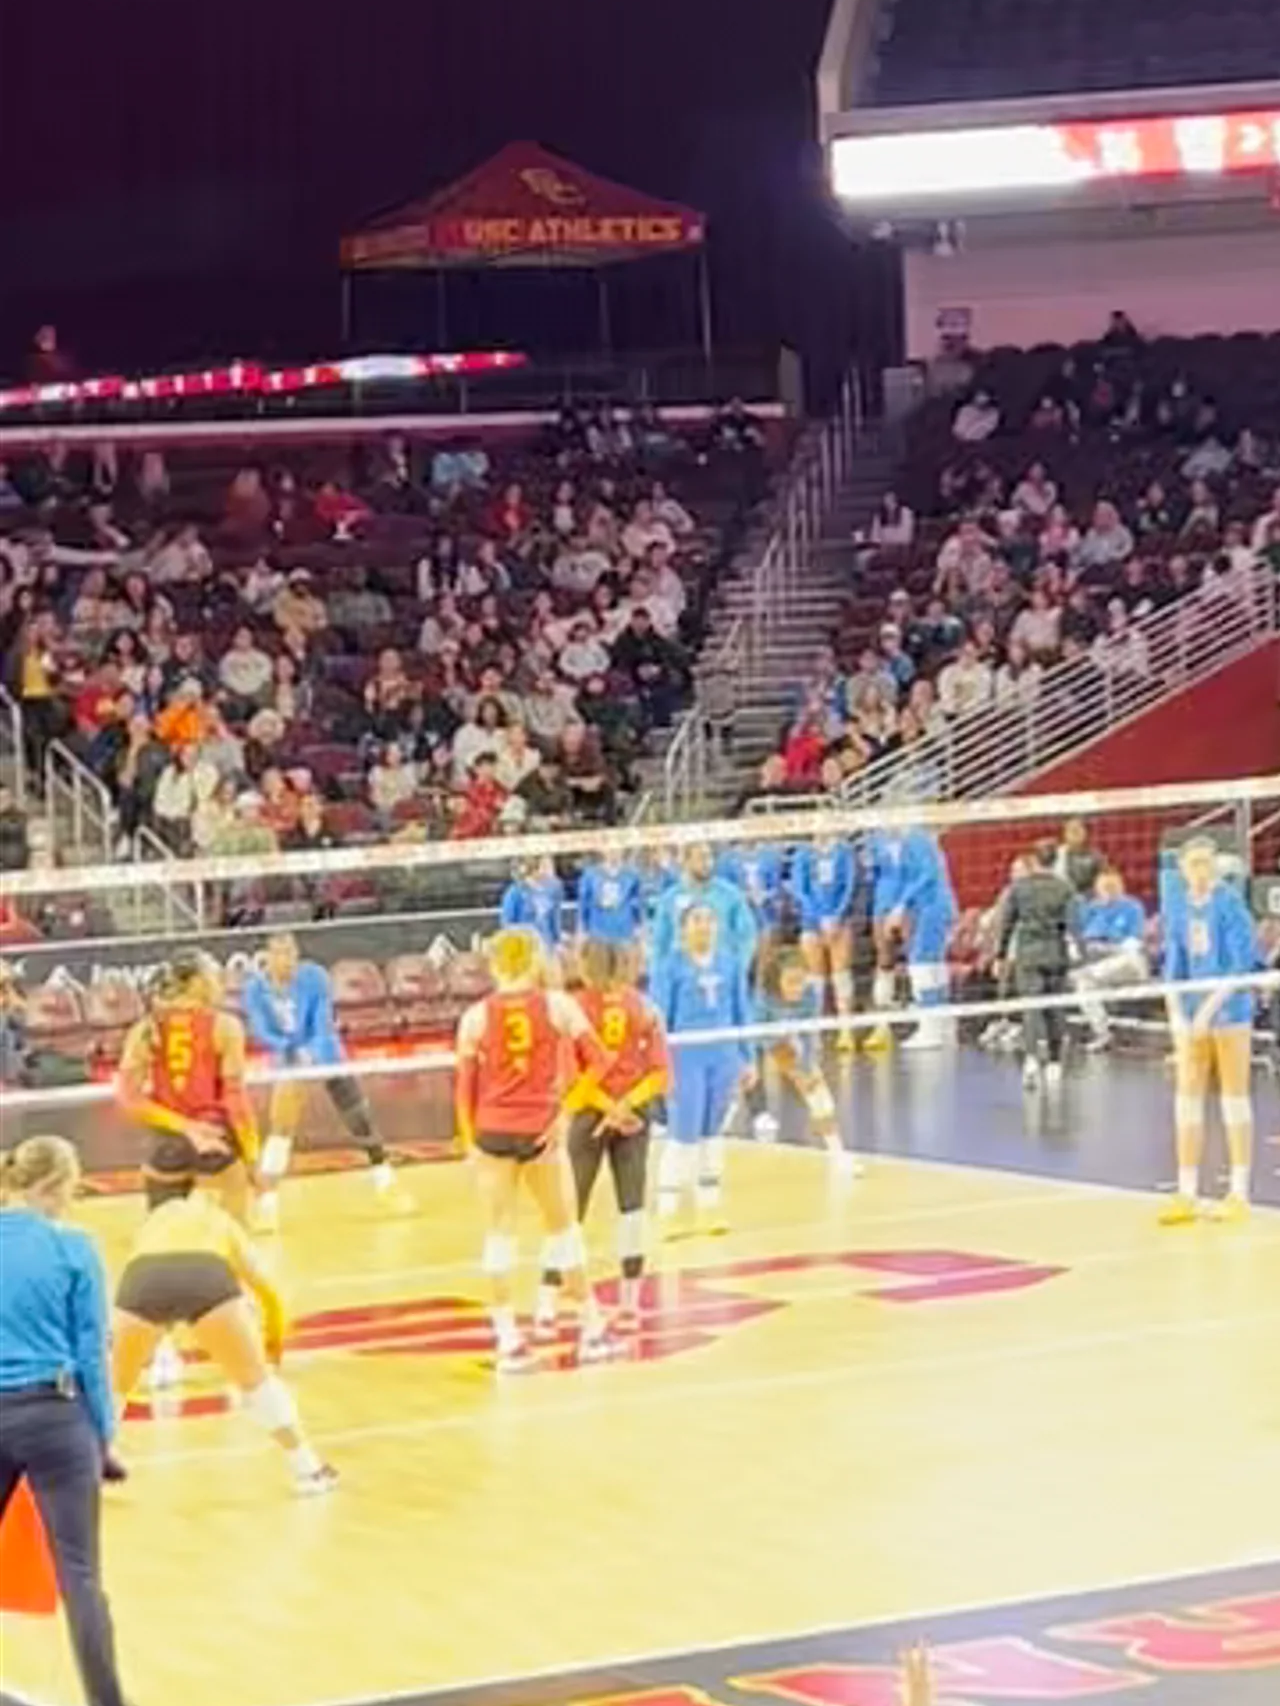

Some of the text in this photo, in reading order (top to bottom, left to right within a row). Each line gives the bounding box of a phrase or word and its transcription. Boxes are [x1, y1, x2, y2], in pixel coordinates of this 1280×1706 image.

[464, 215, 681, 243] USC ATHLETICS
[166, 1020, 192, 1072] 5
[503, 1013, 533, 1053] 3
